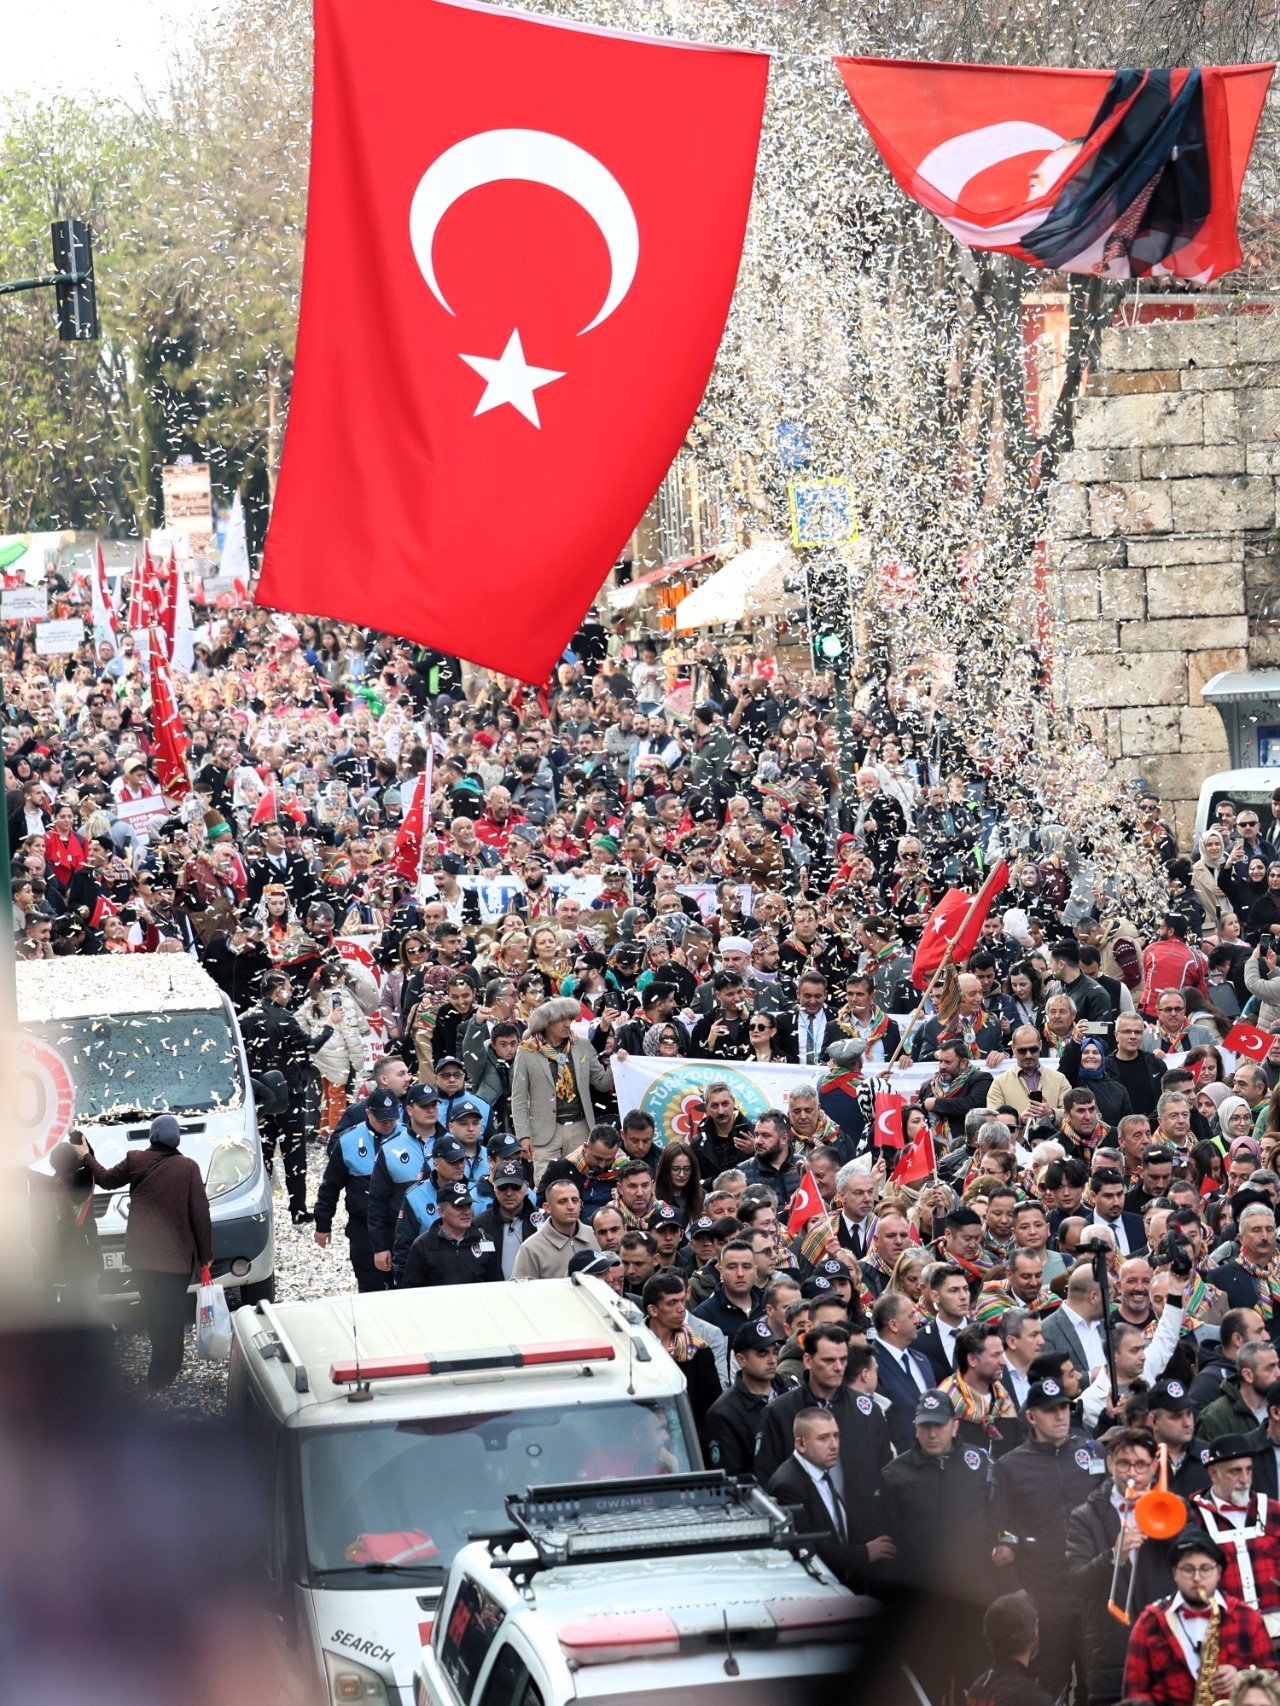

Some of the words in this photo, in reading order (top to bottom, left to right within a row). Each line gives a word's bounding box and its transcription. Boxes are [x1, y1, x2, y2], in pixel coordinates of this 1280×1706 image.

[649, 1072, 687, 1108] TÜRK
[690, 1068, 760, 1105] DÜNYASI
[330, 1629, 396, 1663] SEARCH
